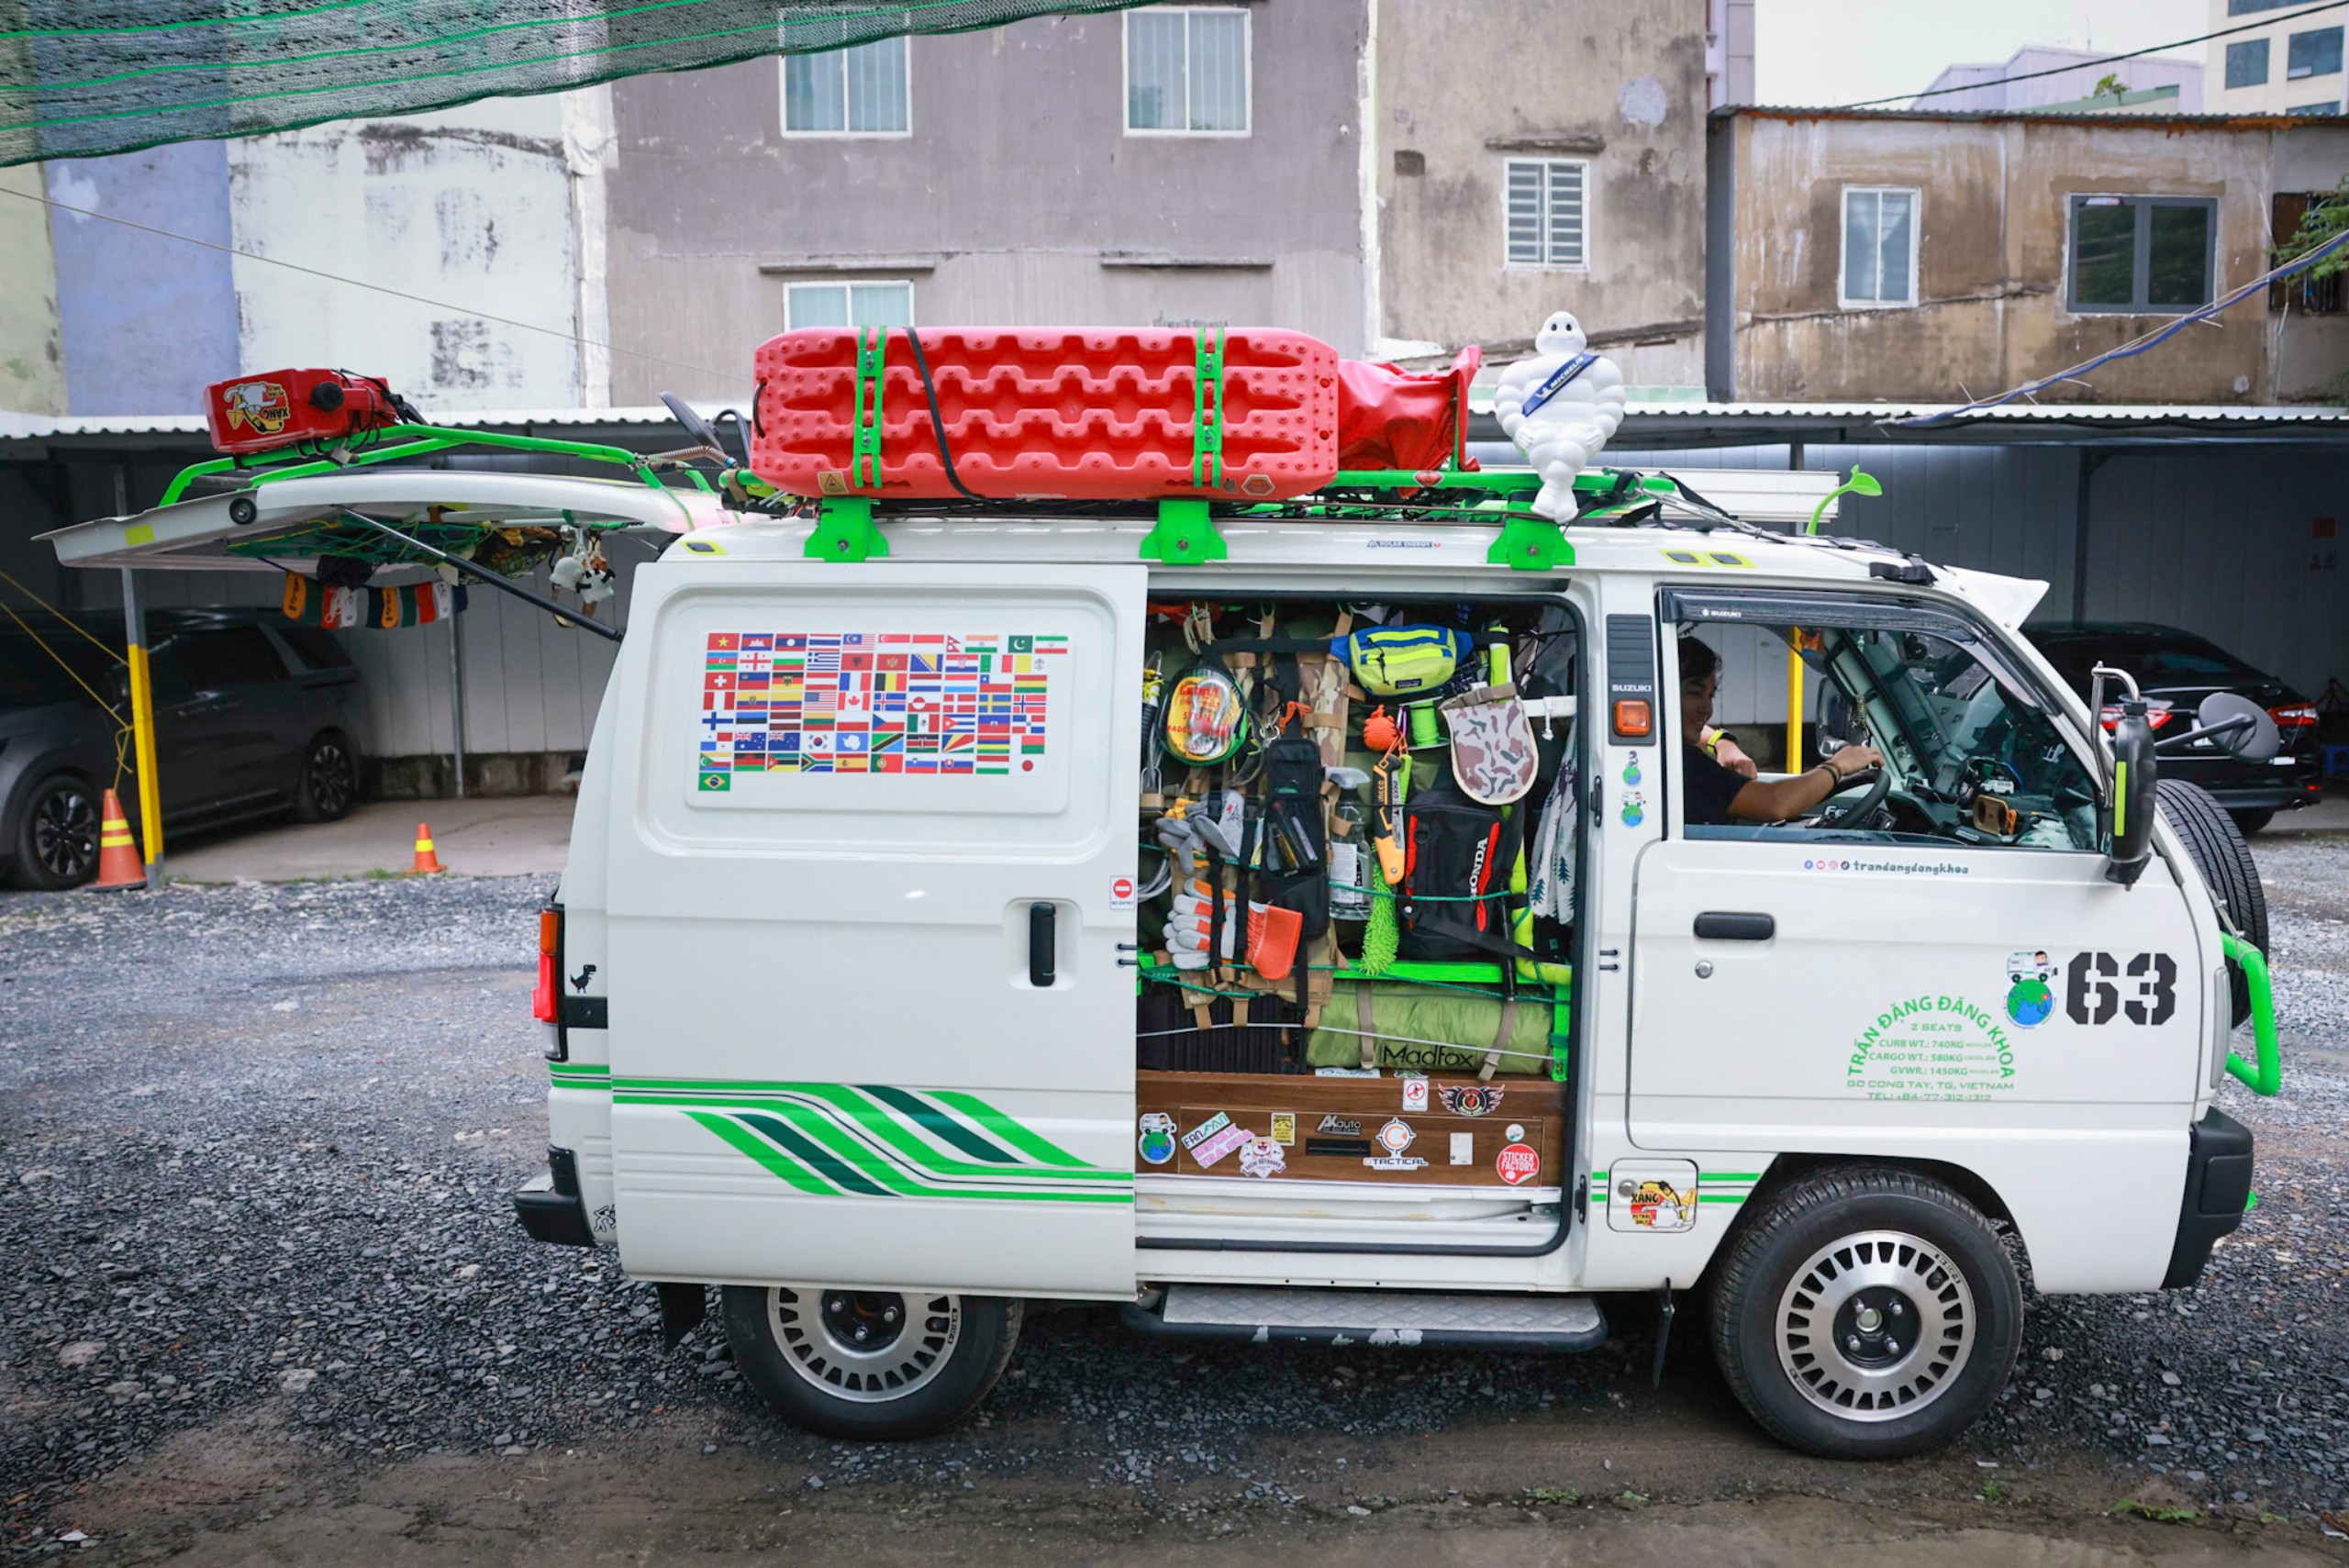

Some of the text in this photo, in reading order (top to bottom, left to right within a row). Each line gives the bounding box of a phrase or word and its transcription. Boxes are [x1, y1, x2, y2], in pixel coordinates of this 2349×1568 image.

[1550, 356, 1584, 388] MICHELIN
[1611, 684, 1652, 693] SUZUKI
[1469, 837, 1488, 900] HONDA
[1853, 860, 1969, 875] trandangdangkhoa
[2065, 951, 2177, 1026] 63
[1910, 1023, 1963, 1032] 2 SEATS
[1879, 1039, 1907, 1048] CURB
[1932, 1040, 1965, 1049] 740KG
[1383, 1043, 1475, 1067] Madfox
[1868, 1052, 1906, 1061] CARGO
[1931, 1054, 1964, 1062] 580KG
[1987, 1025, 2015, 1078] KHOA
[1931, 1067, 1968, 1075] 1450KG
[1847, 1080, 2014, 1091] GO CONG TAY, TG, VIETNAM
[1503, 1151, 1534, 1163] STICKER
[1631, 1193, 1659, 1203] XANG
